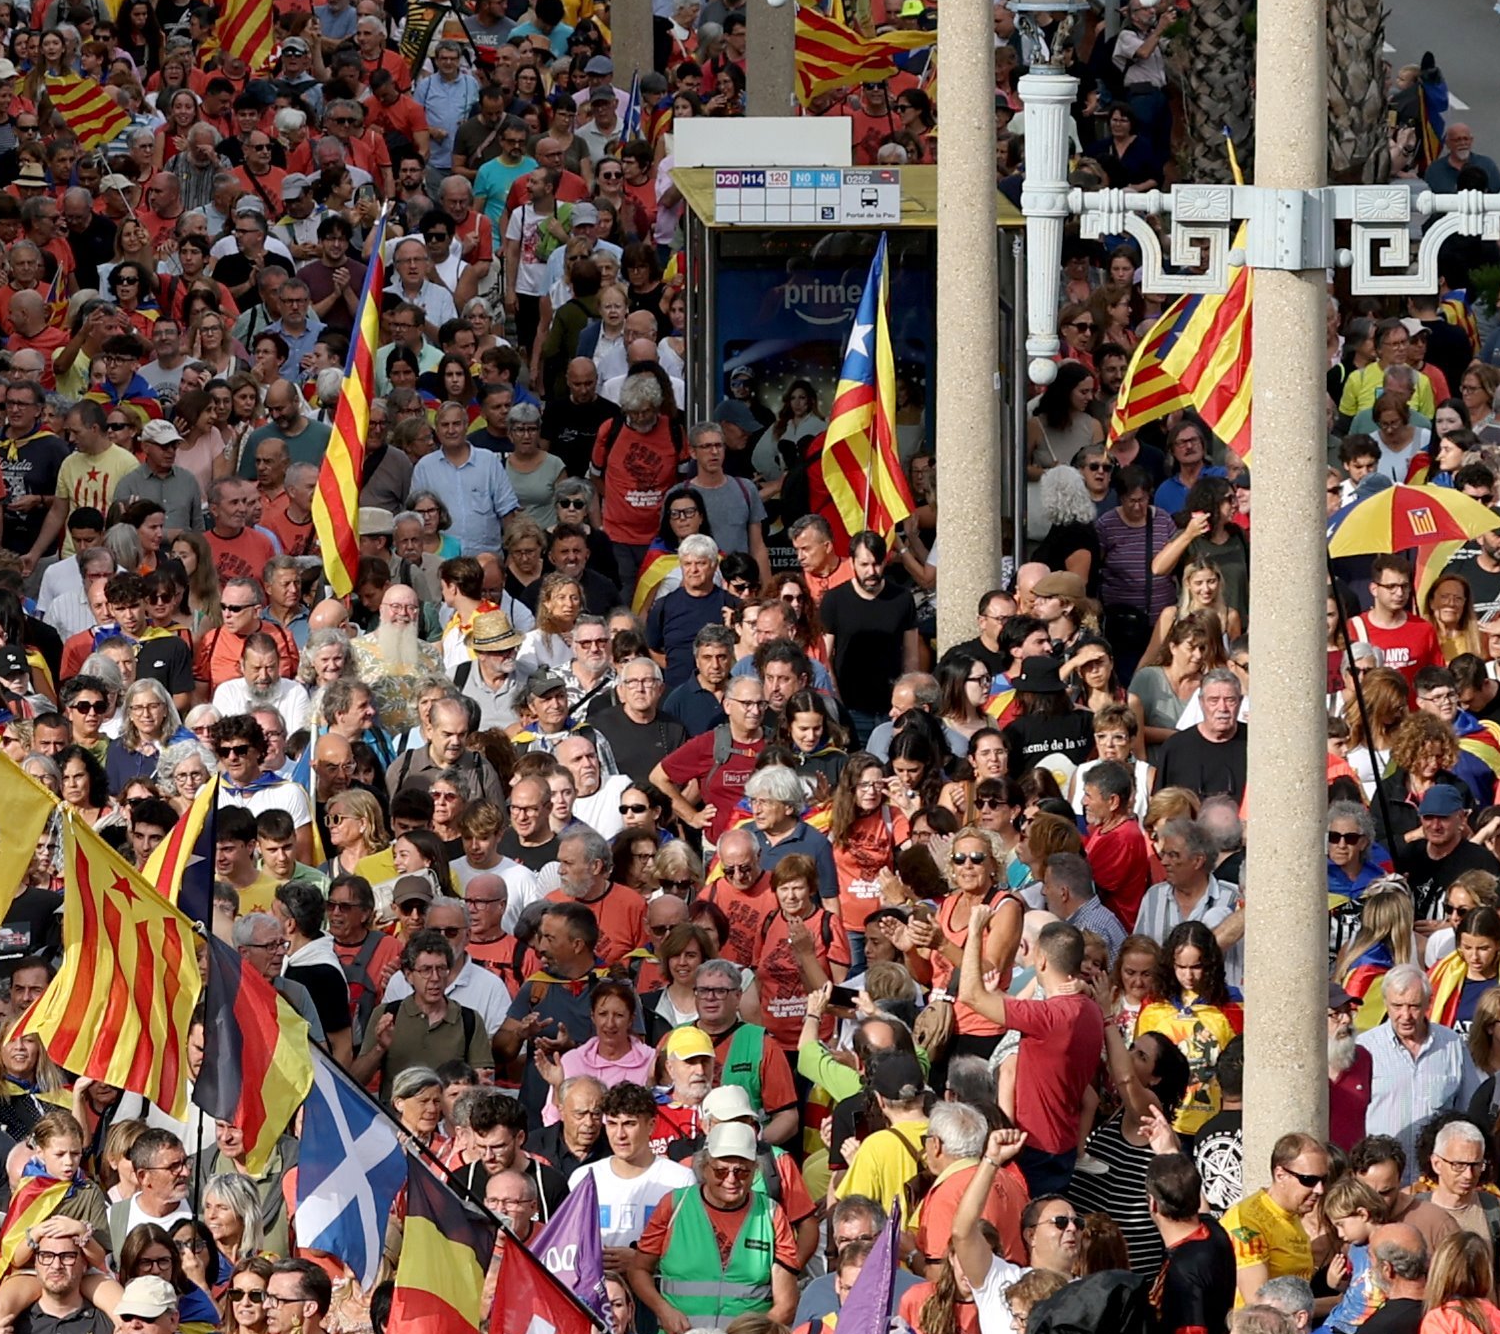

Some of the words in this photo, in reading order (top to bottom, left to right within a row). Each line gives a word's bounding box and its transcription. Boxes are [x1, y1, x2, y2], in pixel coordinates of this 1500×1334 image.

[716, 172, 739, 185] D20
[742, 172, 764, 185] H14
[769, 171, 788, 183] 120
[796, 172, 810, 183] N0
[821, 172, 835, 183] N6
[846, 175, 870, 185] 0252
[883, 212, 896, 220] Pau
[784, 279, 862, 309] prime
[767, 547, 798, 556] ESTREN
[1022, 739, 1049, 754] acmé
[1051, 739, 1064, 750] de
[1065, 737, 1076, 749] la
